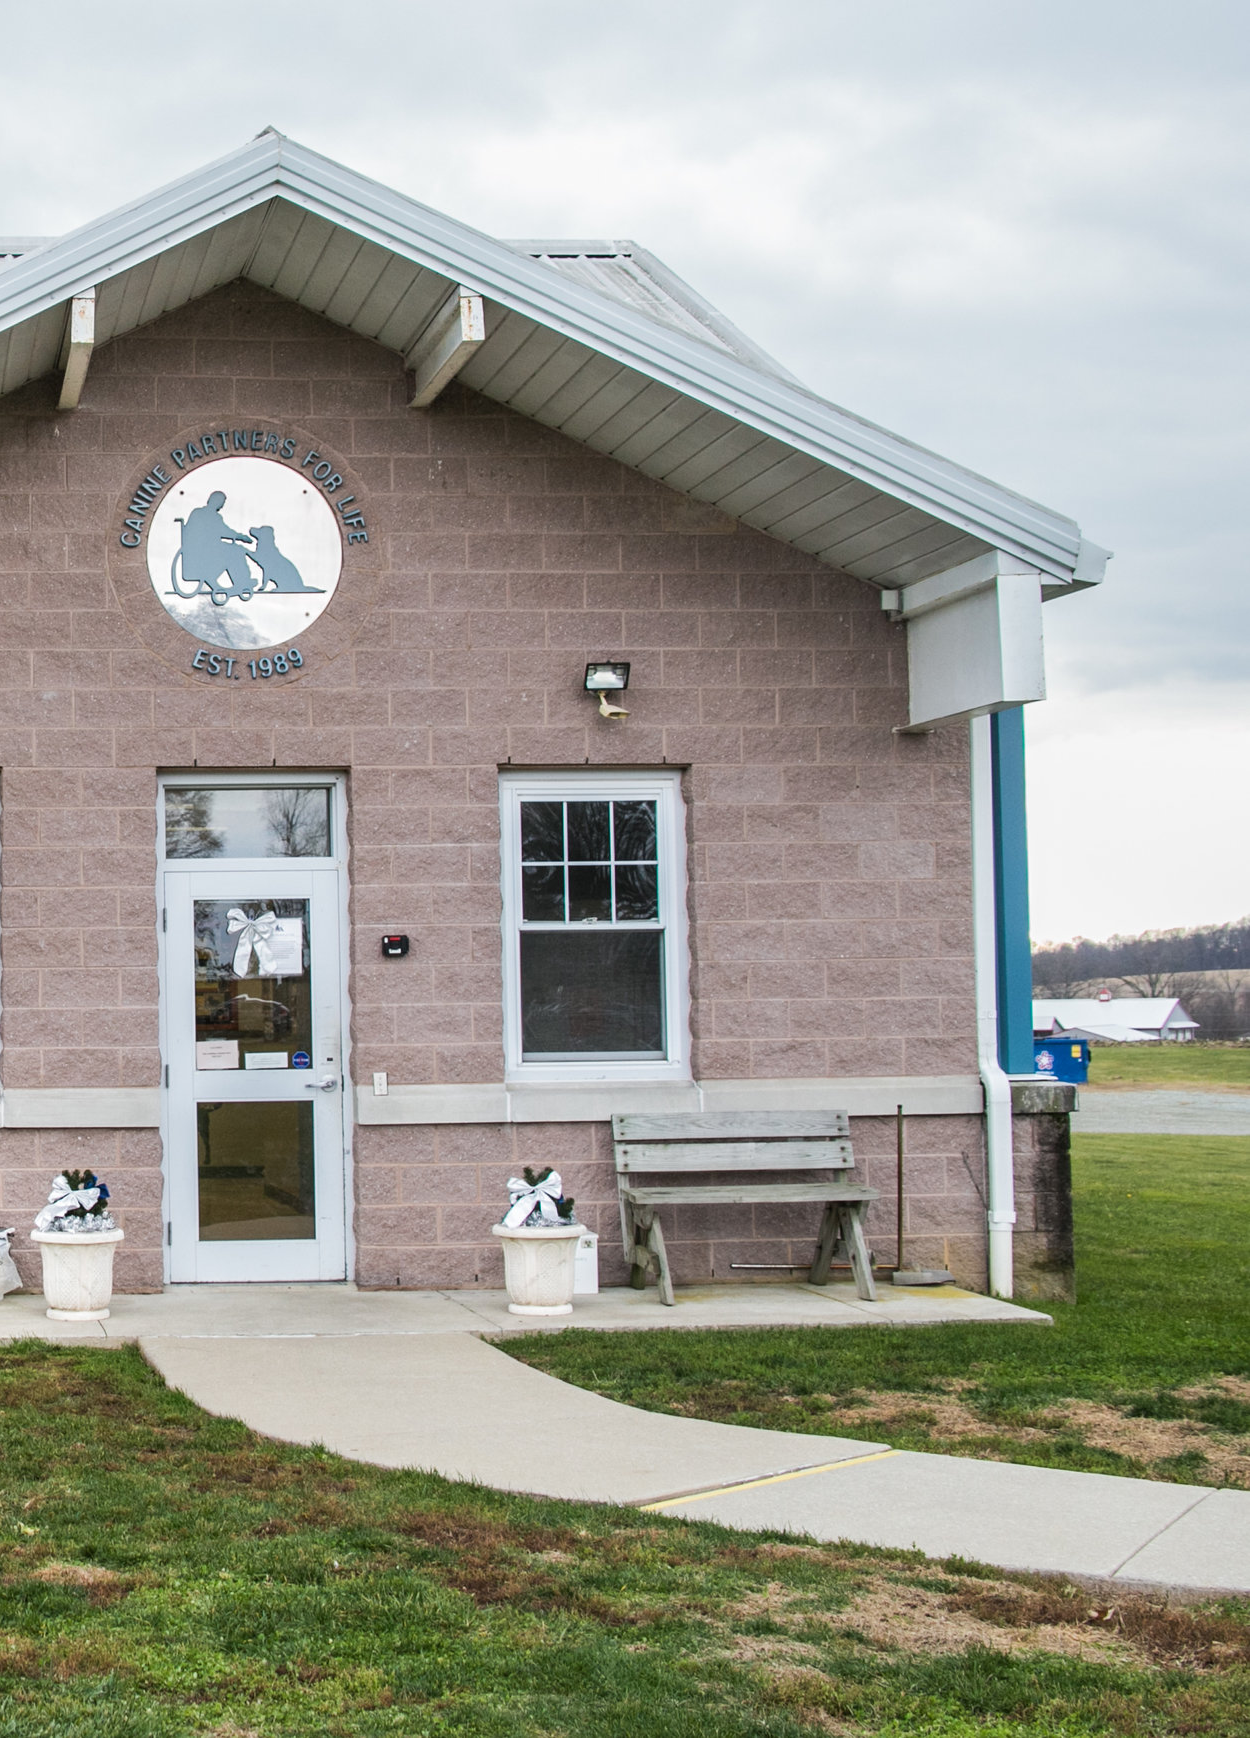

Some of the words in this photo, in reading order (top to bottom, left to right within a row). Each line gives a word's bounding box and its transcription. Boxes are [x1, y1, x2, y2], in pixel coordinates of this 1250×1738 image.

[120, 464, 172, 548] CANINE
[171, 430, 297, 469] PARTNERS
[301, 450, 343, 493] FOR
[336, 495, 369, 546] LIFE
[192, 648, 239, 679] EST.
[248, 648, 304, 679] 1989
